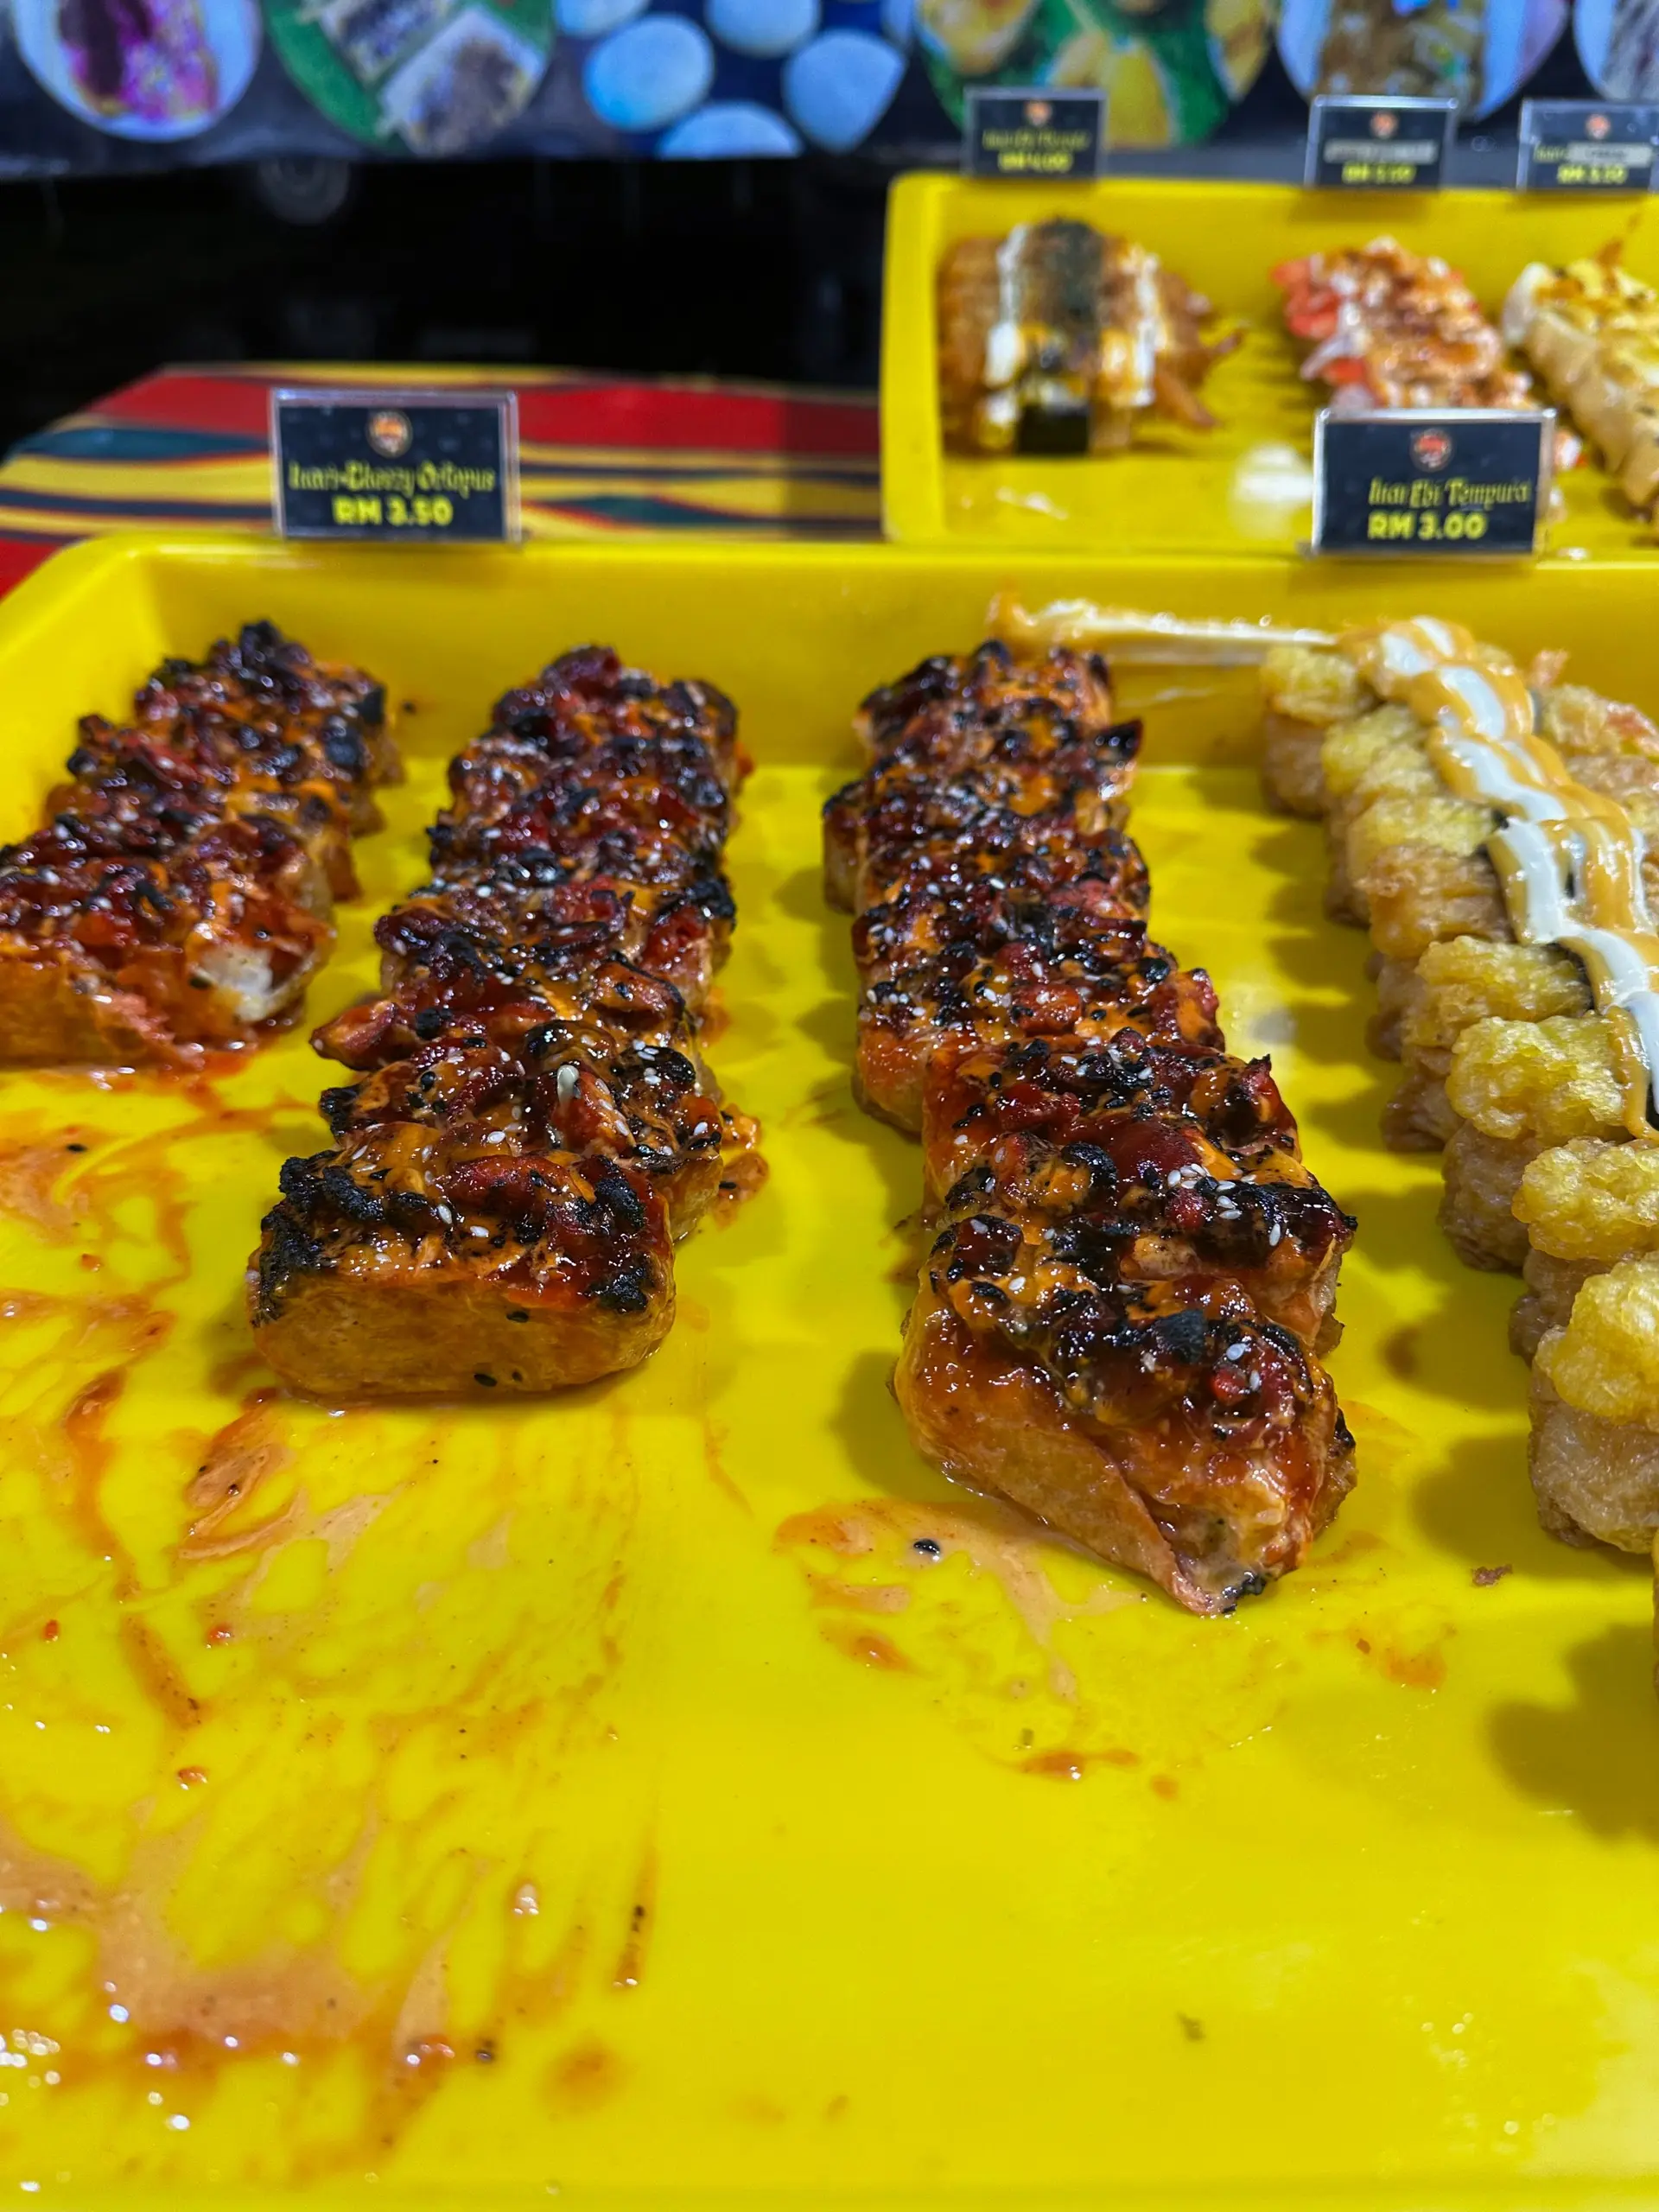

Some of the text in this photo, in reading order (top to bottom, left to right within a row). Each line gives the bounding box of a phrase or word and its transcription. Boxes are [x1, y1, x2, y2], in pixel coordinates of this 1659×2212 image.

[332, 494, 454, 526] RM 3.50
[1445, 477, 1531, 511] Tempura
[1367, 511, 1487, 540] RM 3.00
